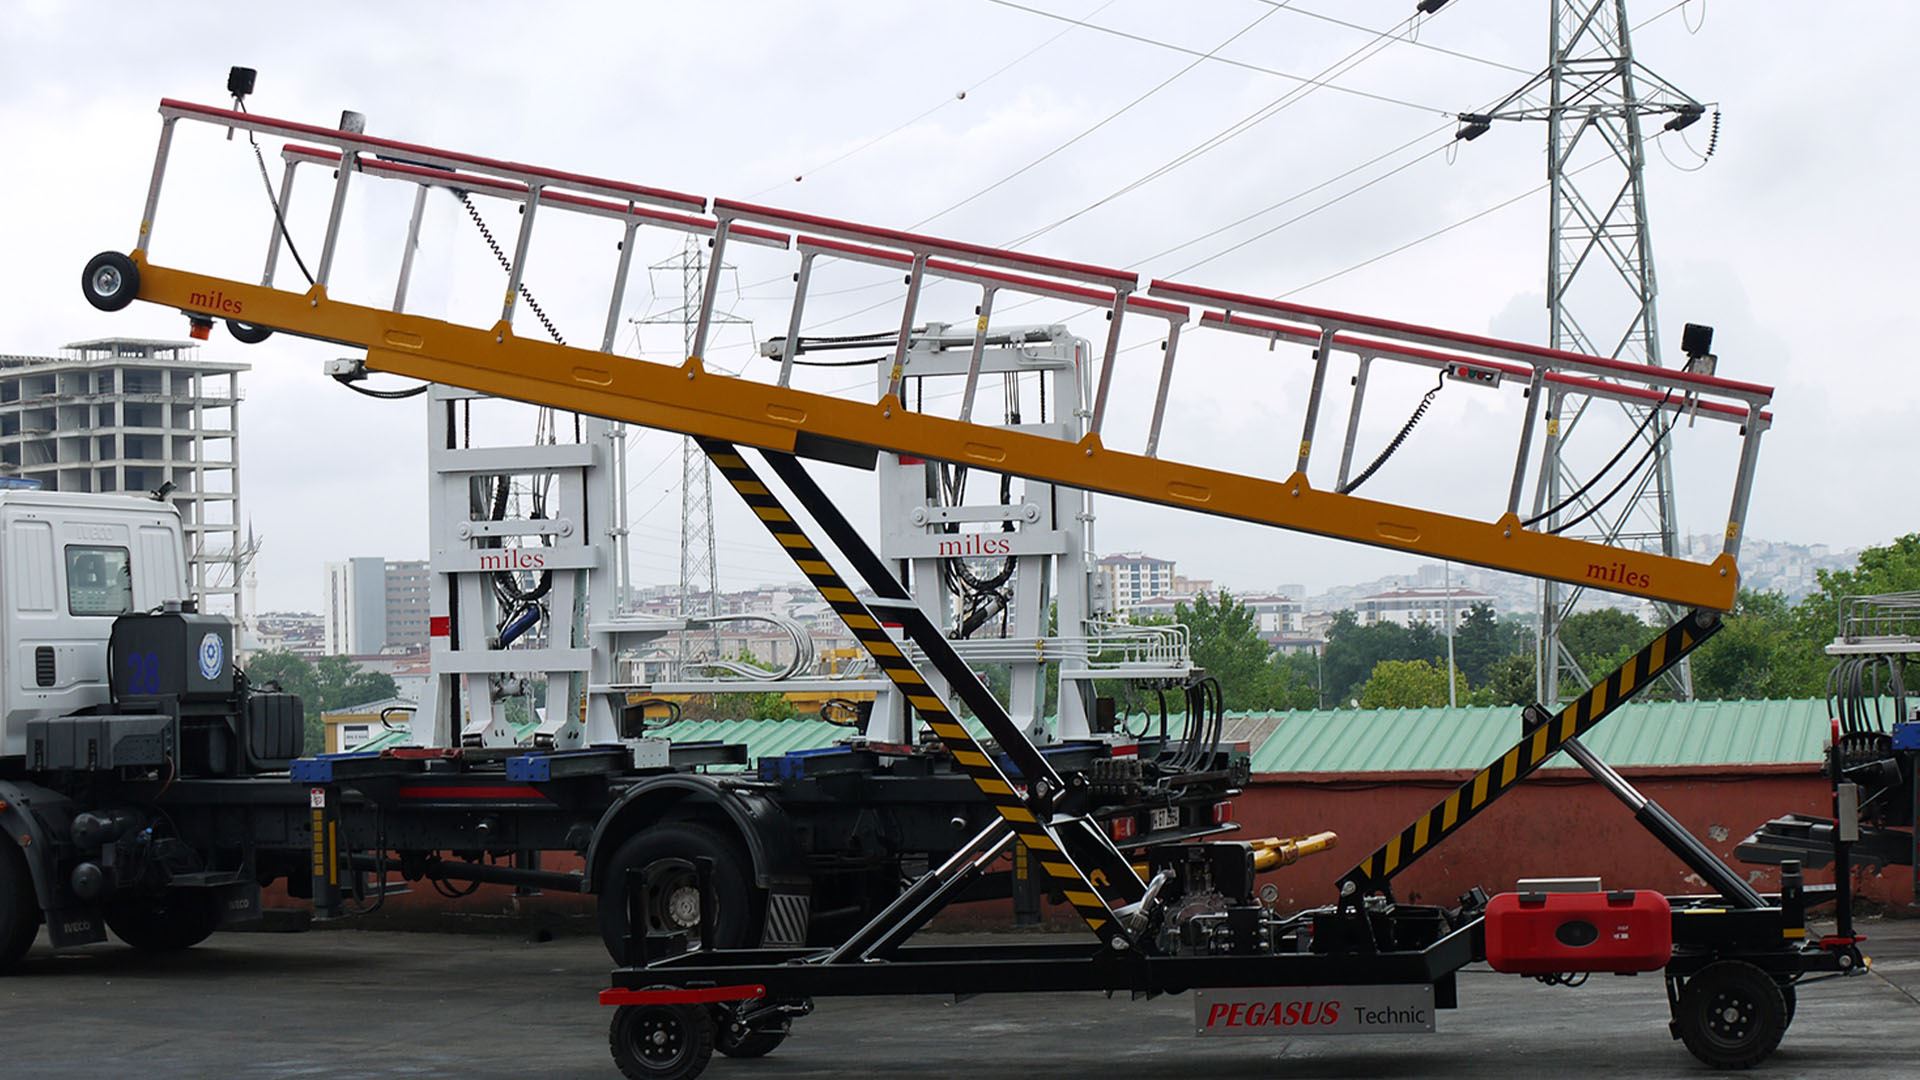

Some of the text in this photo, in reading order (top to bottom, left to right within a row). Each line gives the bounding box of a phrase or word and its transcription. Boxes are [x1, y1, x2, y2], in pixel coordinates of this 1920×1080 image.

[190, 291, 243, 314] miles
[939, 534, 1010, 555] miles
[480, 549, 544, 569] miles
[1586, 562, 1650, 588] miles
[127, 652, 161, 695] 28
[64, 921, 91, 934] IVECO
[1206, 1000, 1425, 1027] PEGASUS Technic
